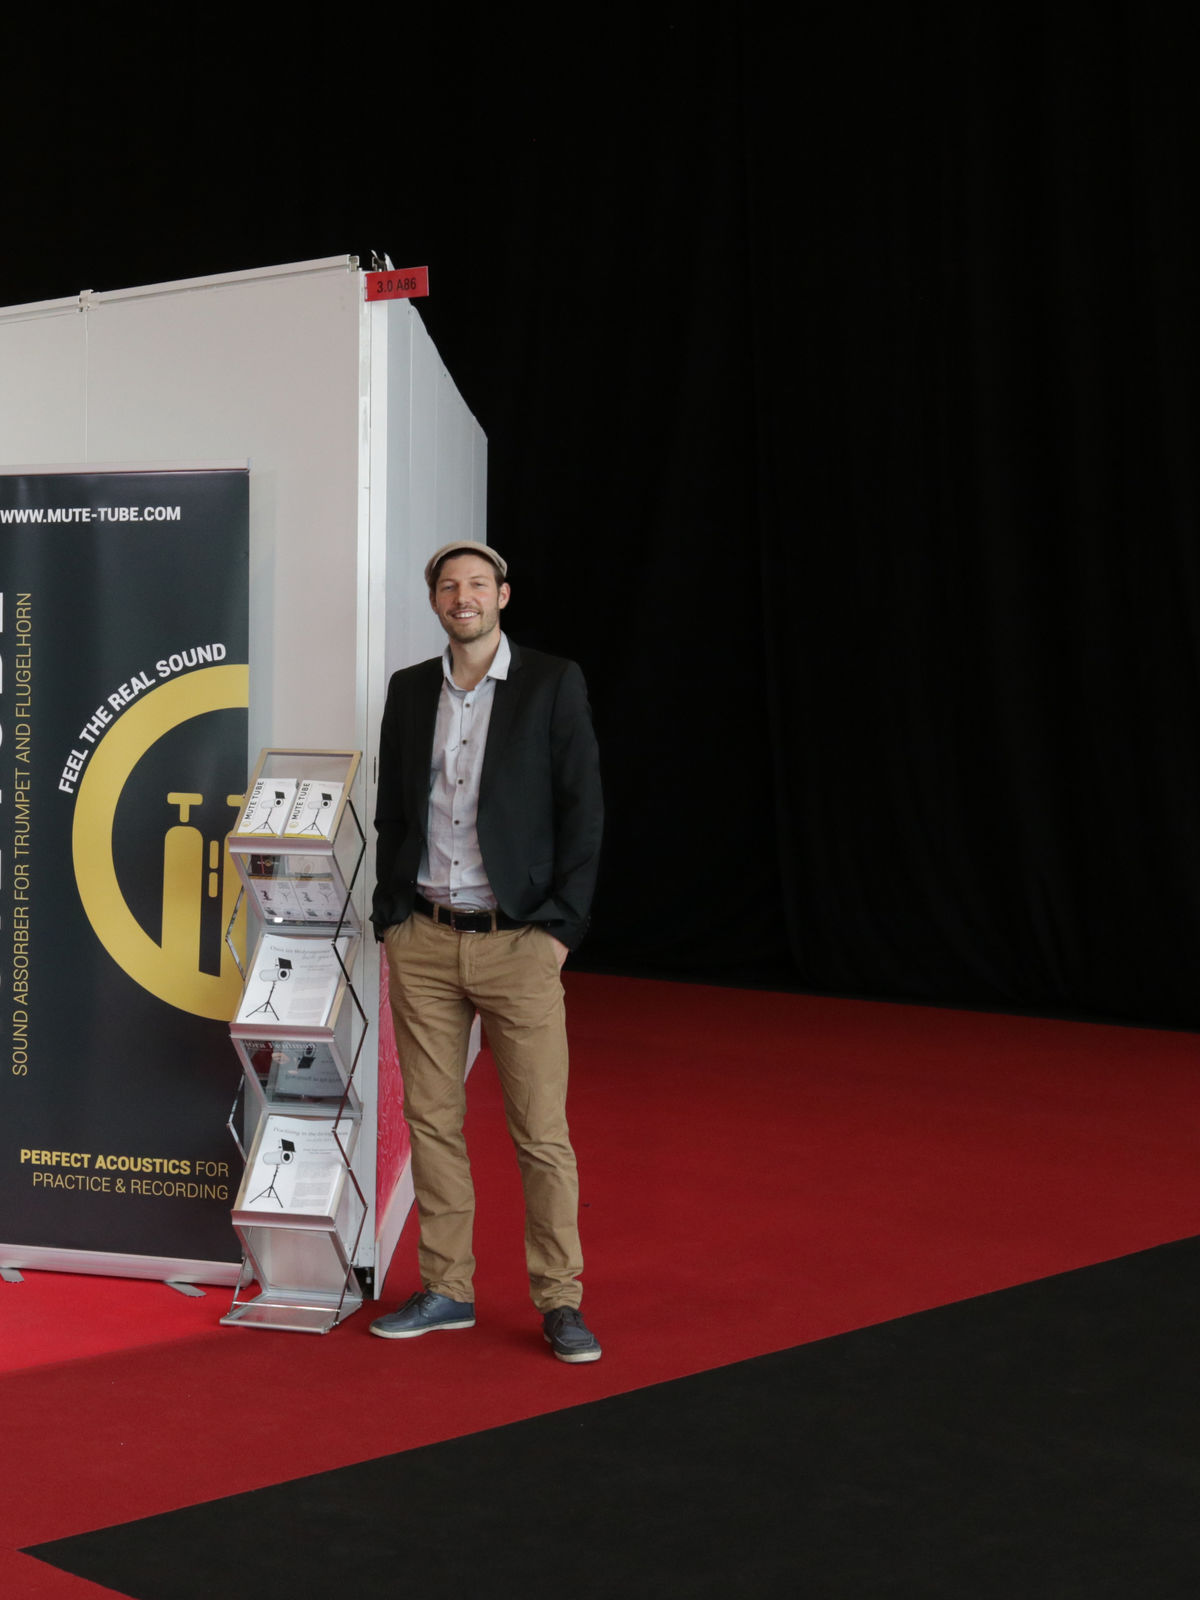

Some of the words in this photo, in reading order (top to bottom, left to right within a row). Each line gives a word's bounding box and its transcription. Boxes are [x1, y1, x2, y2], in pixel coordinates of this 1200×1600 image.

[377, 280, 393, 293] 3.0
[397, 278, 416, 291] A86
[0, 506, 181, 524] WWW.MUTE-TUBE.COM
[16, 592, 32, 717] FLUGELHORN
[58, 749, 89, 794] FEEL
[79, 705, 114, 746] THE
[107, 671, 156, 712] REAL
[155, 642, 227, 679] SOUND
[15, 722, 31, 764] AND
[14, 767, 31, 859] TRUMPET
[244, 801, 258, 820] MUTE
[252, 780, 265, 799] TUBE
[291, 801, 305, 821] MUTE
[298, 782, 312, 800] TUBE
[14, 863, 30, 901] FOR
[13, 906, 30, 1006] ABSORBER
[12, 1010, 29, 1077] SOUND
[20, 1149, 91, 1169] PERFECT
[94, 1154, 191, 1175] ACOUSTICS
[195, 1161, 230, 1178] FOR
[33, 1171, 111, 1193] PRACTICE
[115, 1177, 127, 1194] &
[130, 1180, 229, 1201] RECORDING
